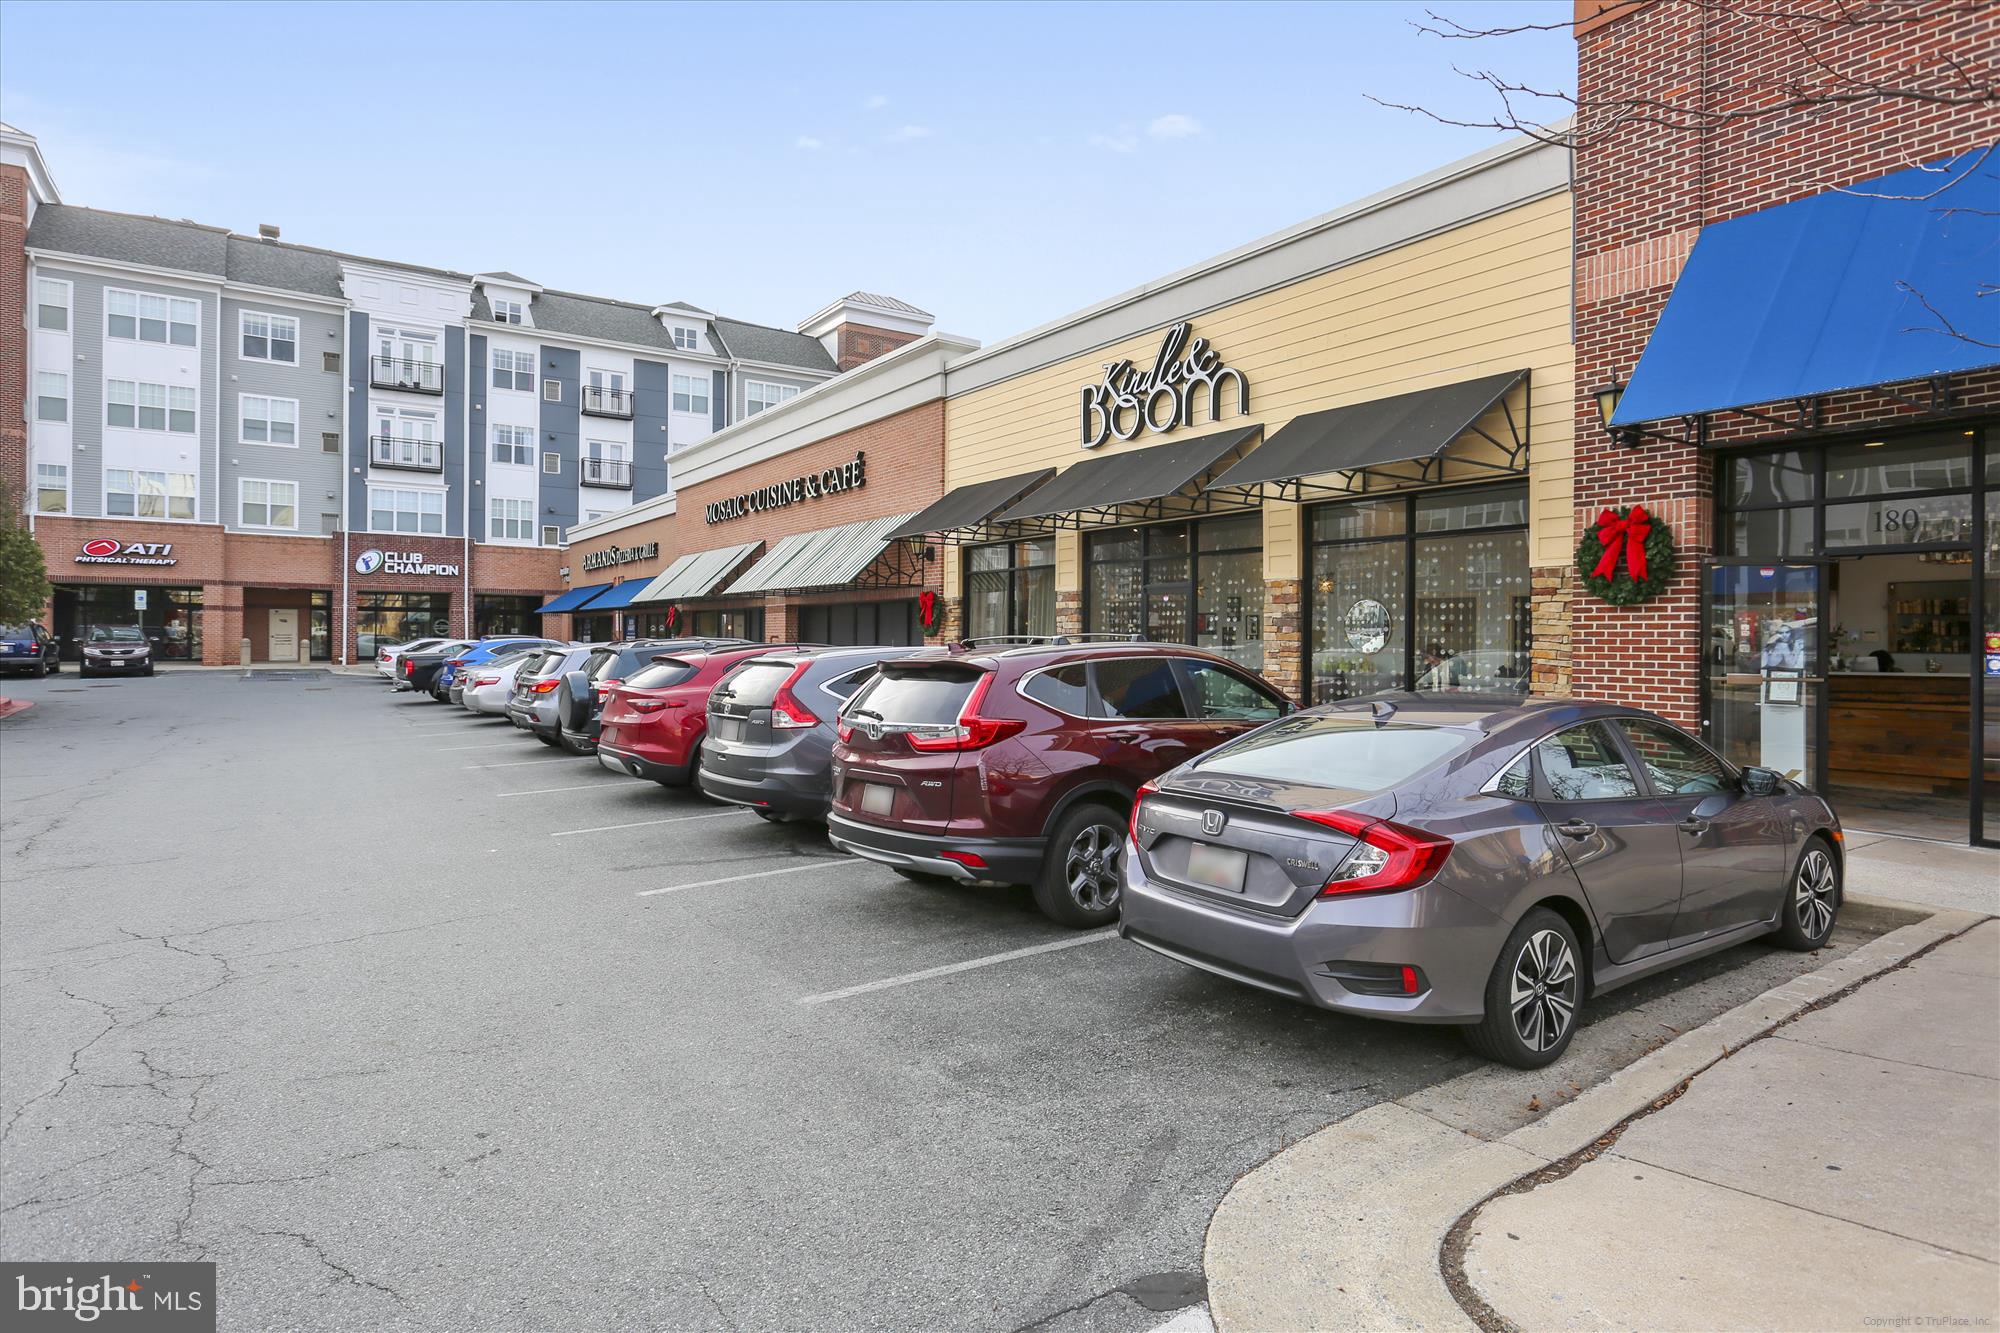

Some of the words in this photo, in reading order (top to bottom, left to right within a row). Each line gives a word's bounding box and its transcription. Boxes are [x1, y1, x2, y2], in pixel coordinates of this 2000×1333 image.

[1097, 322, 1188, 404] Kindle
[1183, 337, 1220, 380] &
[704, 493, 748, 525] MOSAIC
[749, 477, 804, 513] CUISINE
[805, 474, 819, 499] &
[820, 451, 866, 495] CAFÉ
[1873, 508, 1920, 533] 180
[122, 543, 174, 556] ATI
[74, 556, 129, 565] PHYSICAL
[129, 557, 177, 566] THERAPY
[384, 551, 423, 564] CLUB
[384, 563, 459, 576] CHAMPION
